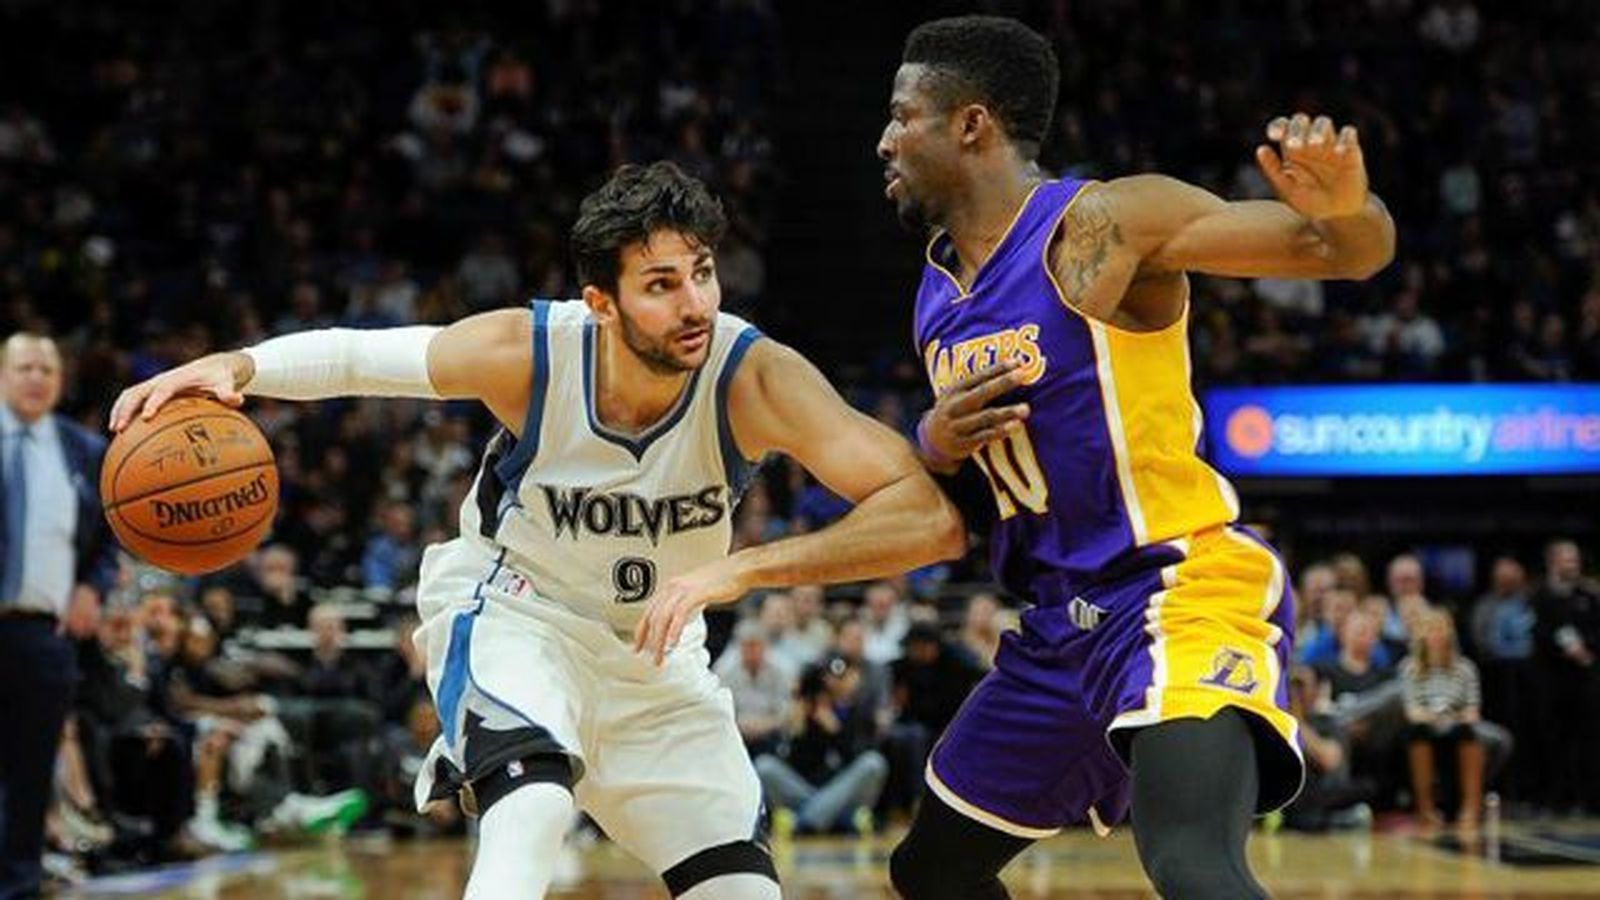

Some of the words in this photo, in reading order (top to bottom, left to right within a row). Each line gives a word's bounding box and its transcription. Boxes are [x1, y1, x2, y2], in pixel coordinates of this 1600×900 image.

[154, 473, 268, 528] SPALDING
[537, 483, 726, 547] WOLVES
[612, 556, 656, 603] 9
